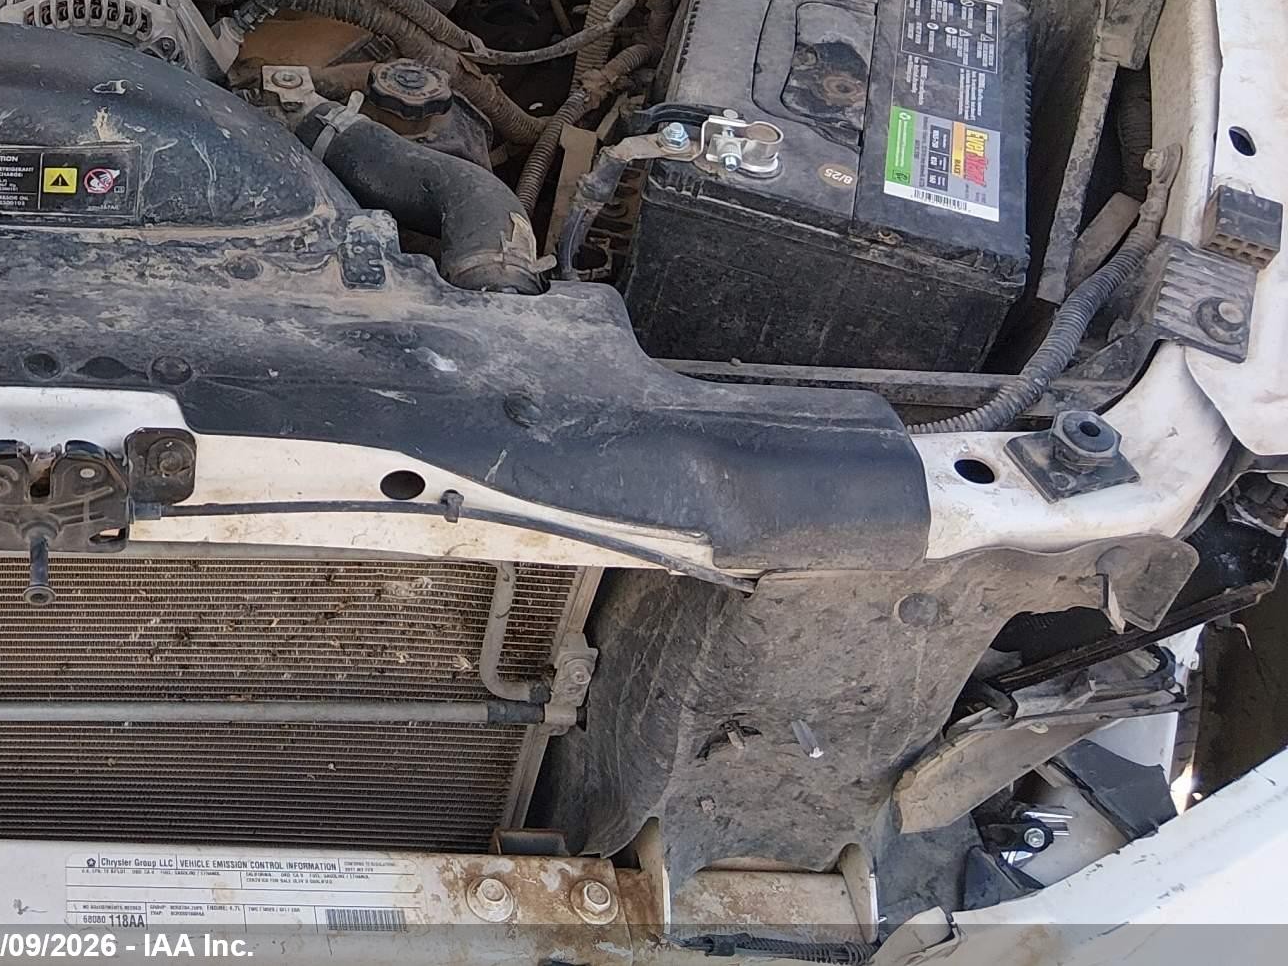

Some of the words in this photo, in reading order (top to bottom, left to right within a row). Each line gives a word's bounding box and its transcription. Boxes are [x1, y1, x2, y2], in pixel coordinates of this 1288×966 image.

[966, 128, 988, 186] EverStart
[824, 168, 853, 184] 8/25
[101, 858, 132, 868] Chrysler
[134, 858, 157, 868] Group
[159, 859, 173, 867] LLC
[180, 860, 209, 868] VEHICLE
[212, 861, 247, 869] EMISSION
[250, 861, 284, 870] CONTROL
[286, 862, 337, 871] INFORMATION
[83, 915, 106, 924] 68080
[109, 914, 145, 928] 118AA
